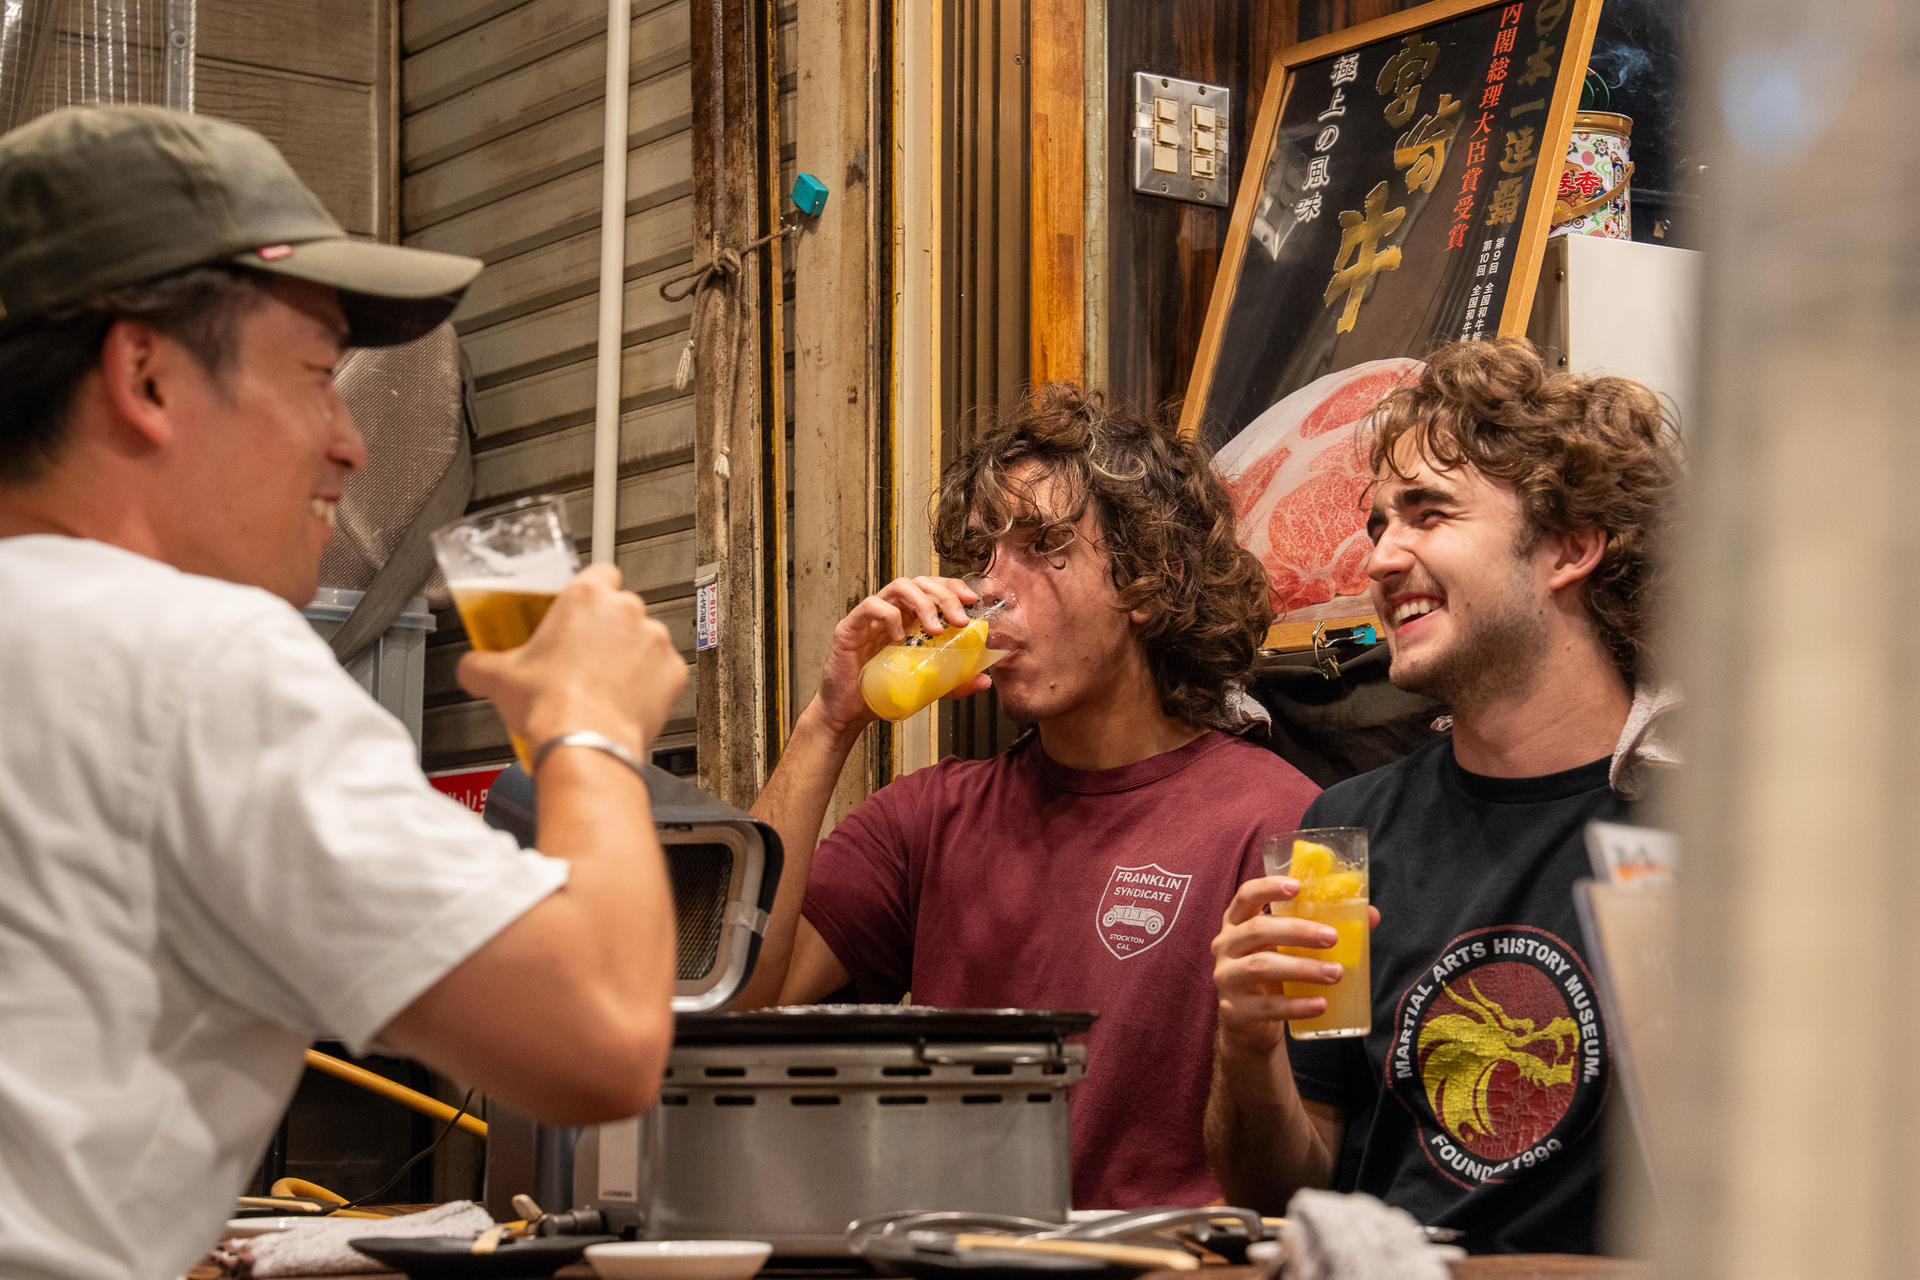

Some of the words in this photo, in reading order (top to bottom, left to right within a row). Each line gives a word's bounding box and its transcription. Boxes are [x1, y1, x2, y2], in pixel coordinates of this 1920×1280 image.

[1294, 53, 1361, 223] 極上の風味
[1447, 3, 1524, 251] 内閣総理大臣賞受賞
[1476, 240, 1493, 276] 第10回
[1489, 237, 1506, 274] 第9回
[1114, 886, 1172, 903] SYNDICATE
[1115, 872, 1182, 890] FRANKLIN
[1109, 933, 1145, 944] STOCKTON
[1395, 983, 1433, 1079] MARTIAL
[1431, 941, 1487, 983] ARTS
[1493, 937, 1572, 977] HISTORY
[1511, 1138, 1563, 1170] 1999
